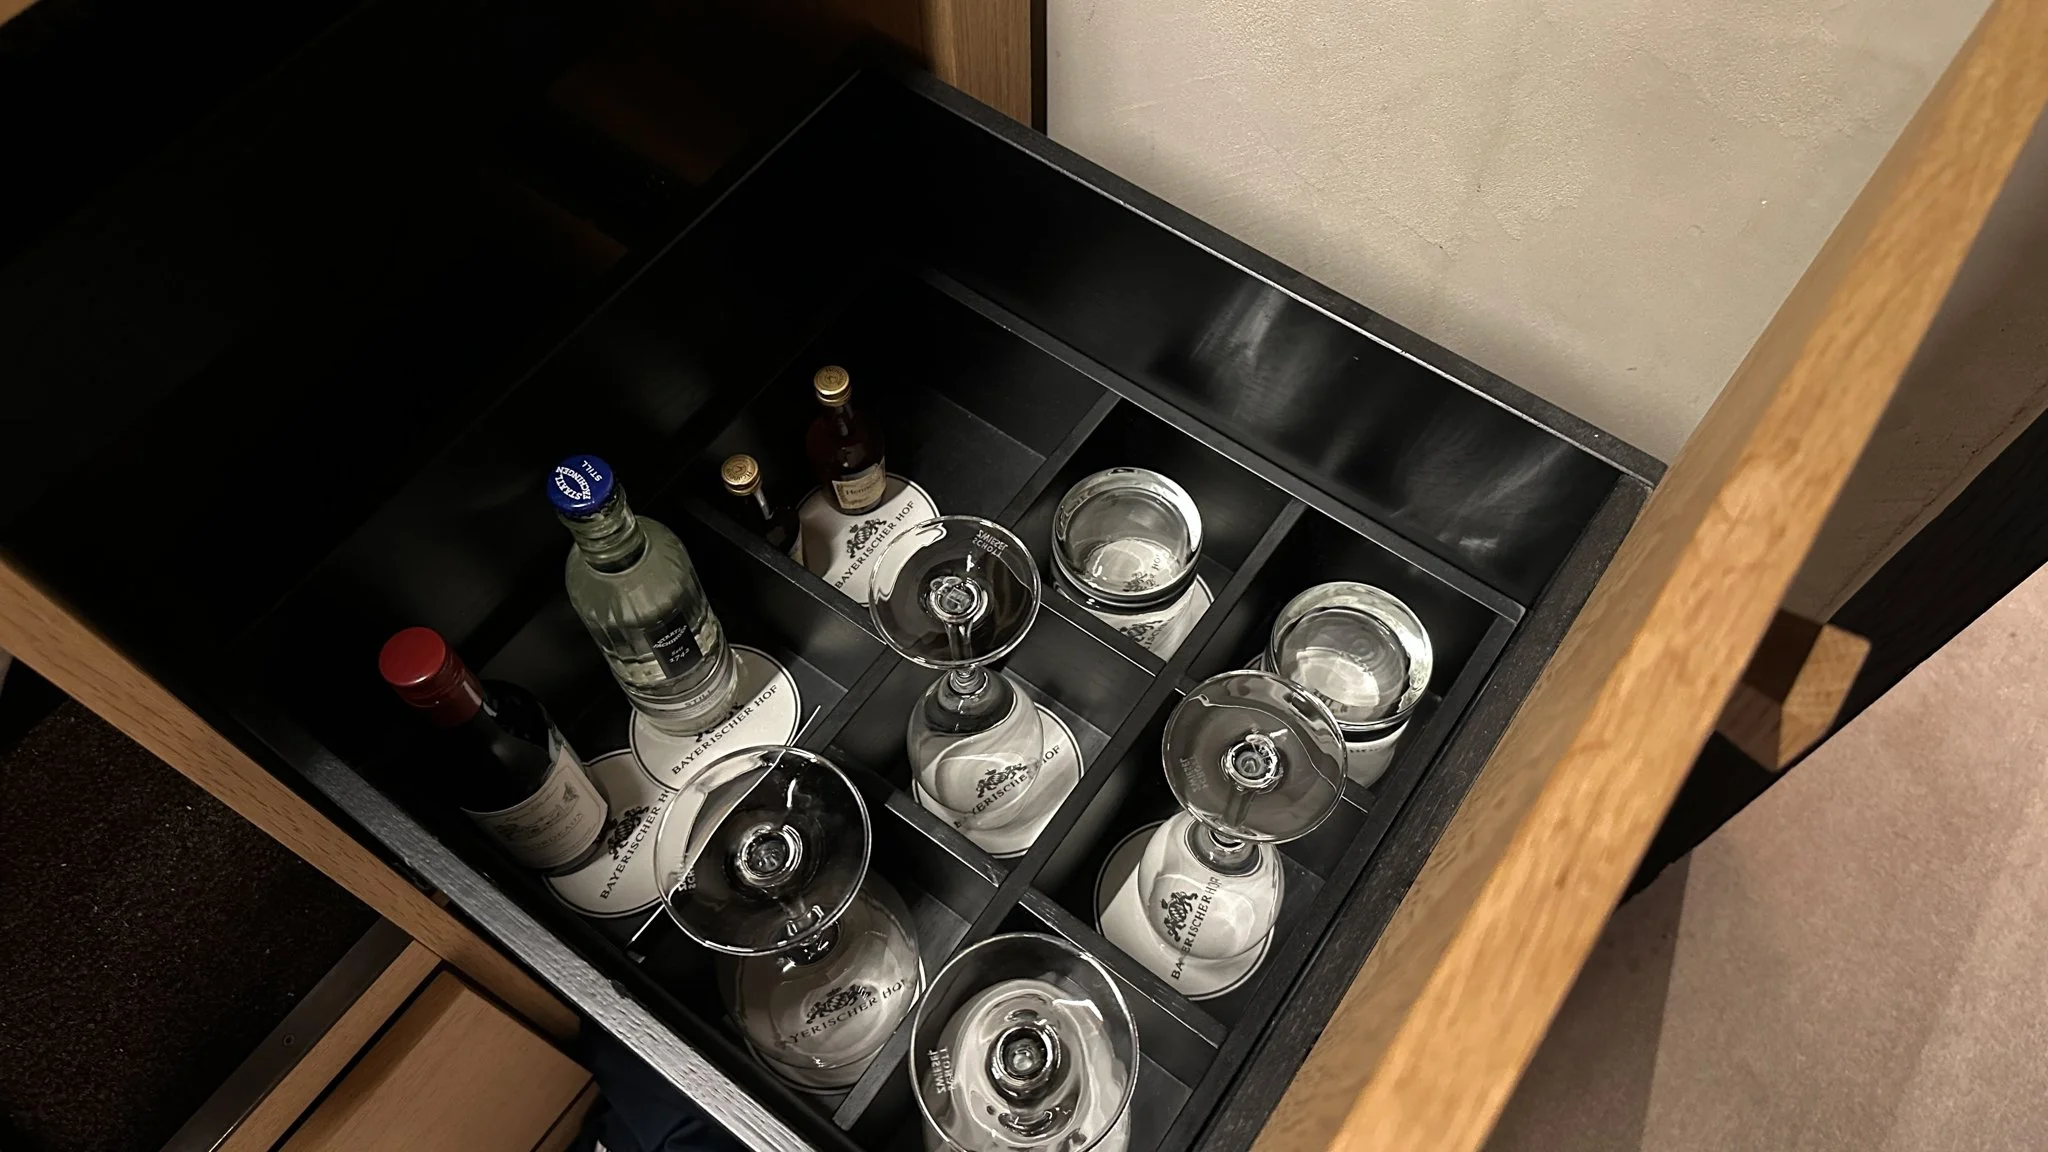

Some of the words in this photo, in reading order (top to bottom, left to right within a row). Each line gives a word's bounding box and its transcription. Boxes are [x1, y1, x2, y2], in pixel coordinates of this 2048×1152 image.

[555, 466, 592, 500] FACHINGEN
[581, 460, 603, 482] STILL
[834, 521, 897, 589] BAYERISCHER
[895, 500, 916, 522] HOF
[671, 707, 753, 775] BAYERISCHER
[754, 684, 778, 707] HOF
[600, 806, 661, 899] BAYERISCHER
[786, 998, 878, 1044] YERISCHER
